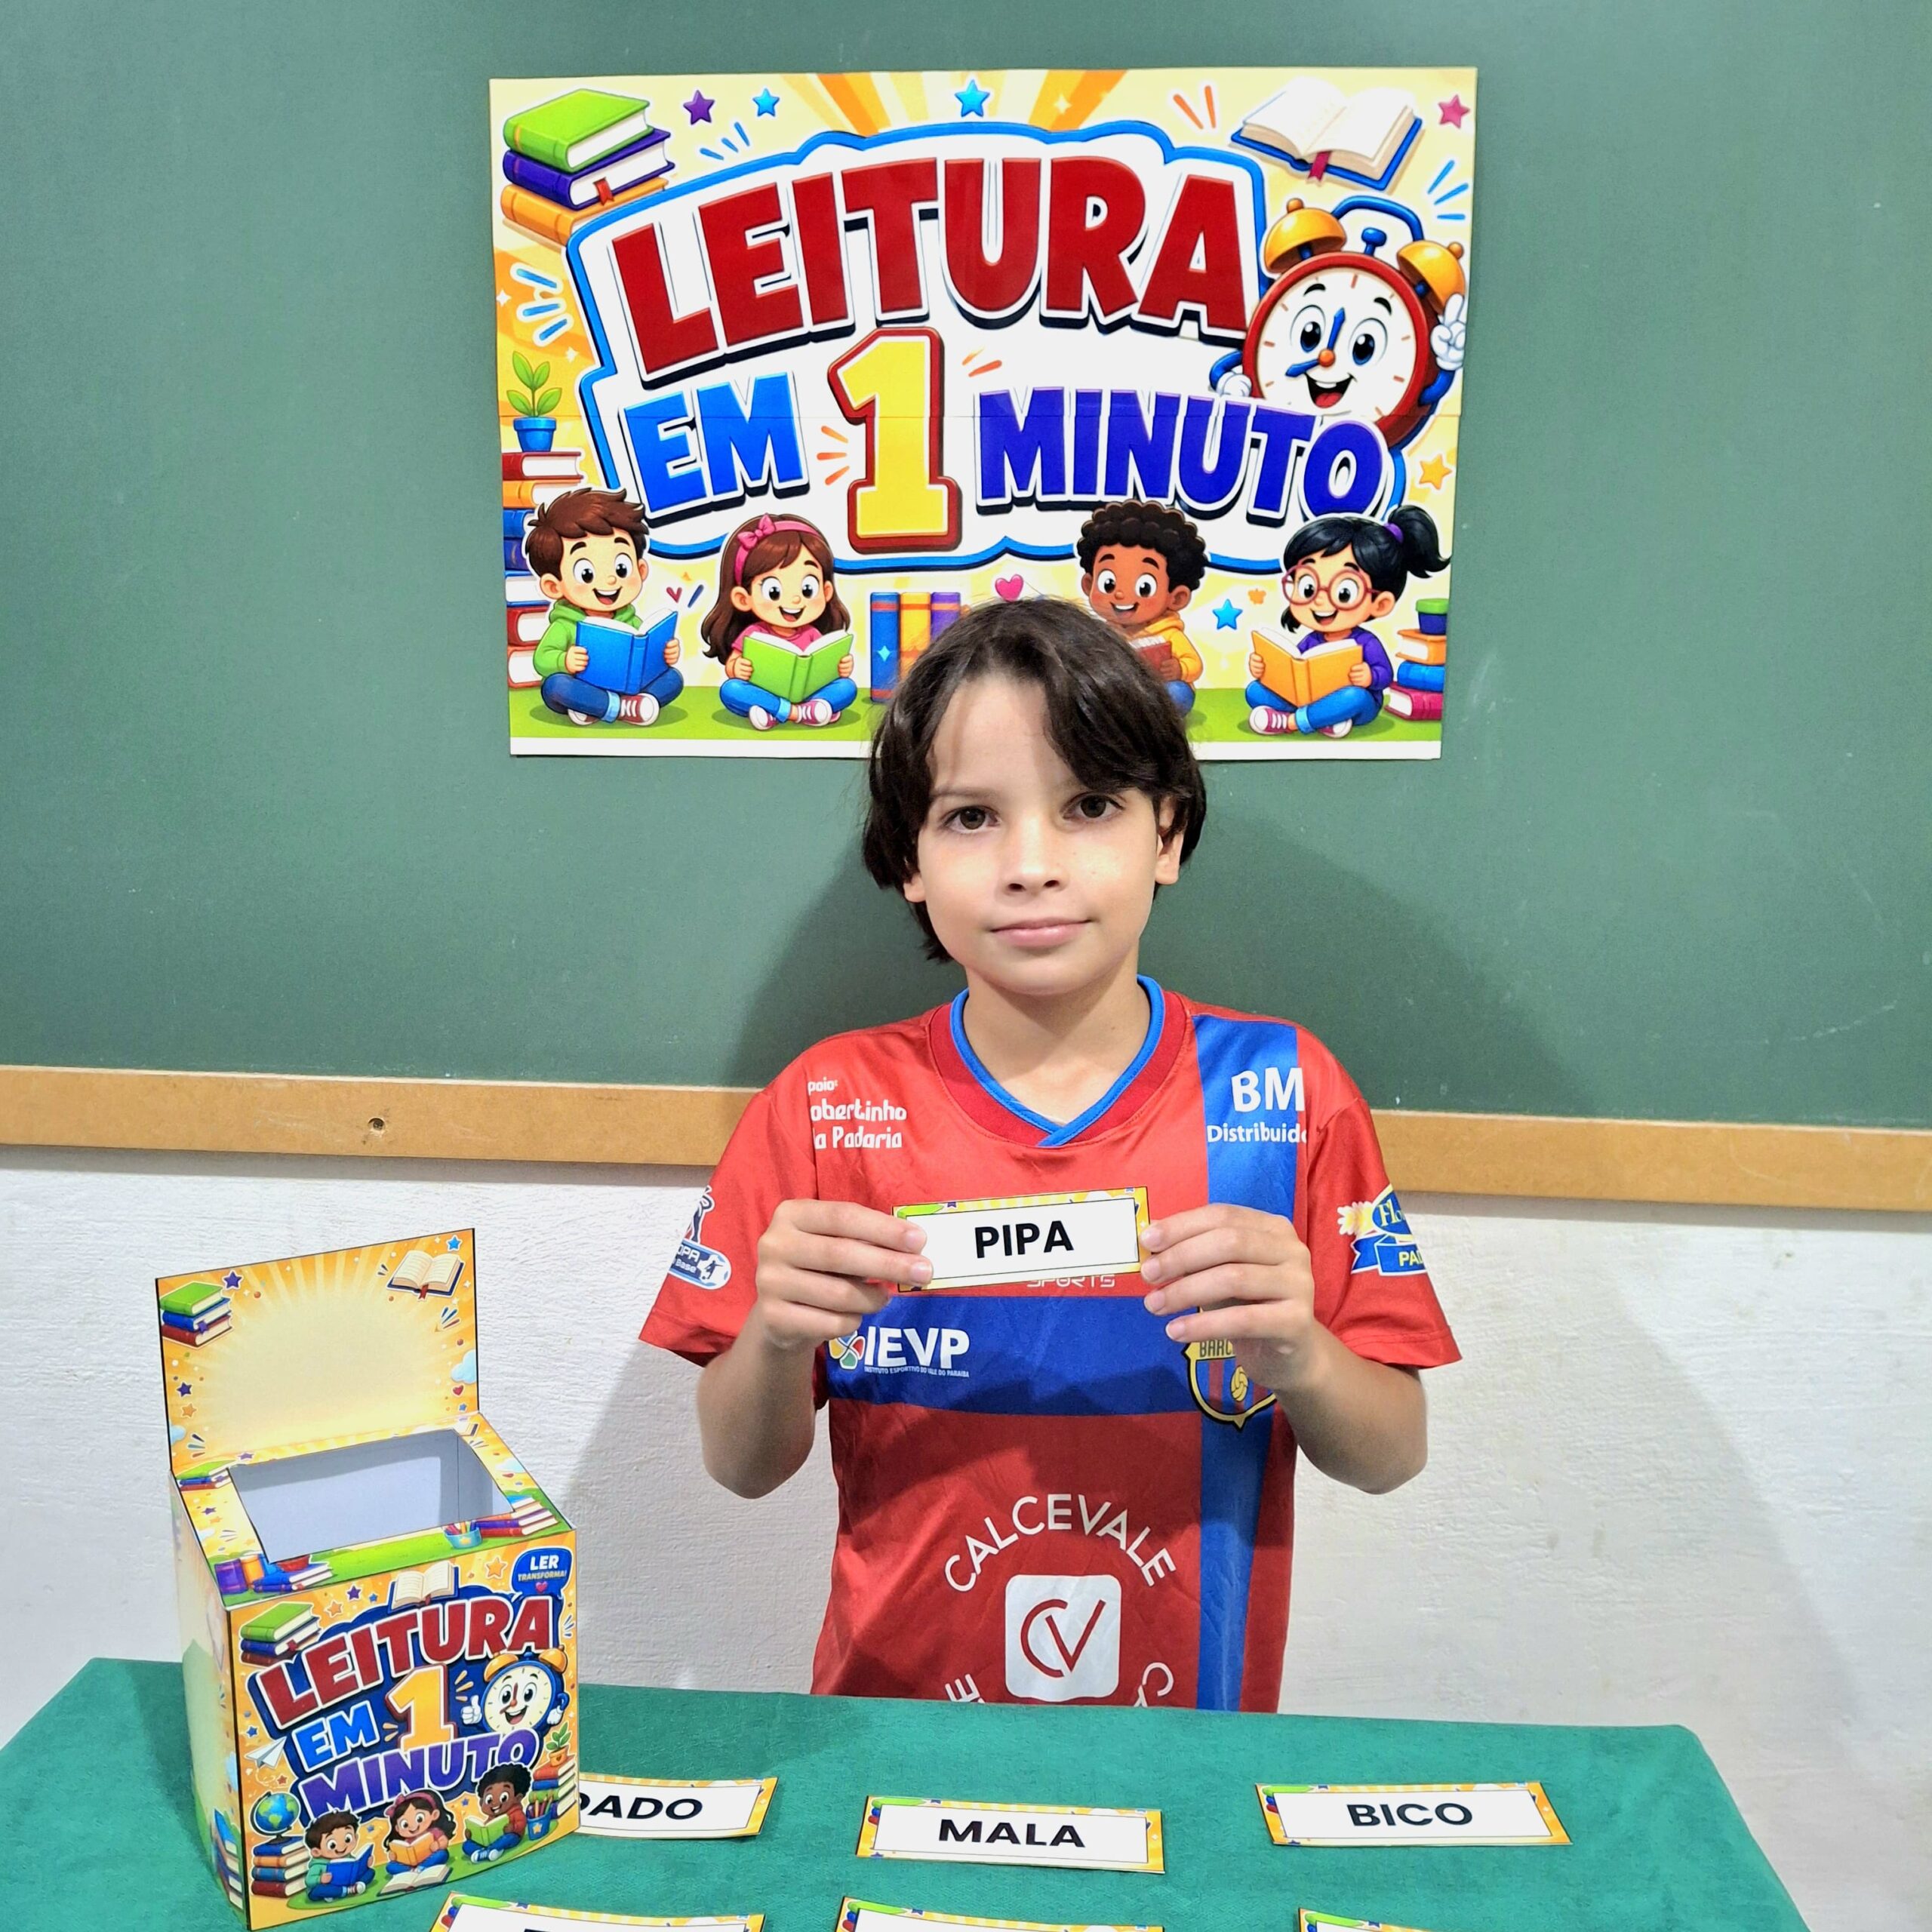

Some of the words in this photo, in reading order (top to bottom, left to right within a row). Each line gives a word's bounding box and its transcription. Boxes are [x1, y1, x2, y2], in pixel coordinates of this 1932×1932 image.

[611, 155, 1247, 377] LEITURA
[623, 372, 805, 513] EM
[829, 328, 961, 553] 1
[980, 387, 1383, 517] MINUTO
[1232, 1067, 1305, 1112] BM
[813, 1128, 826, 1149] a
[832, 1126, 902, 1148] Padaria
[1377, 1198, 1406, 1226] Flo
[974, 1220, 1074, 1258] PIPA
[865, 1326, 970, 1369] IEVP
[530, 1555, 559, 1571] LER
[945, 1494, 1177, 1592] CALCEVALE
[257, 1596, 554, 1728] LEITURA
[294, 1701, 379, 1771] EM
[386, 1663, 457, 1749] 1
[300, 1727, 540, 1819] MINUTO
[939, 1819, 1086, 1848] MALA
[1346, 1803, 1472, 1826] BICO
